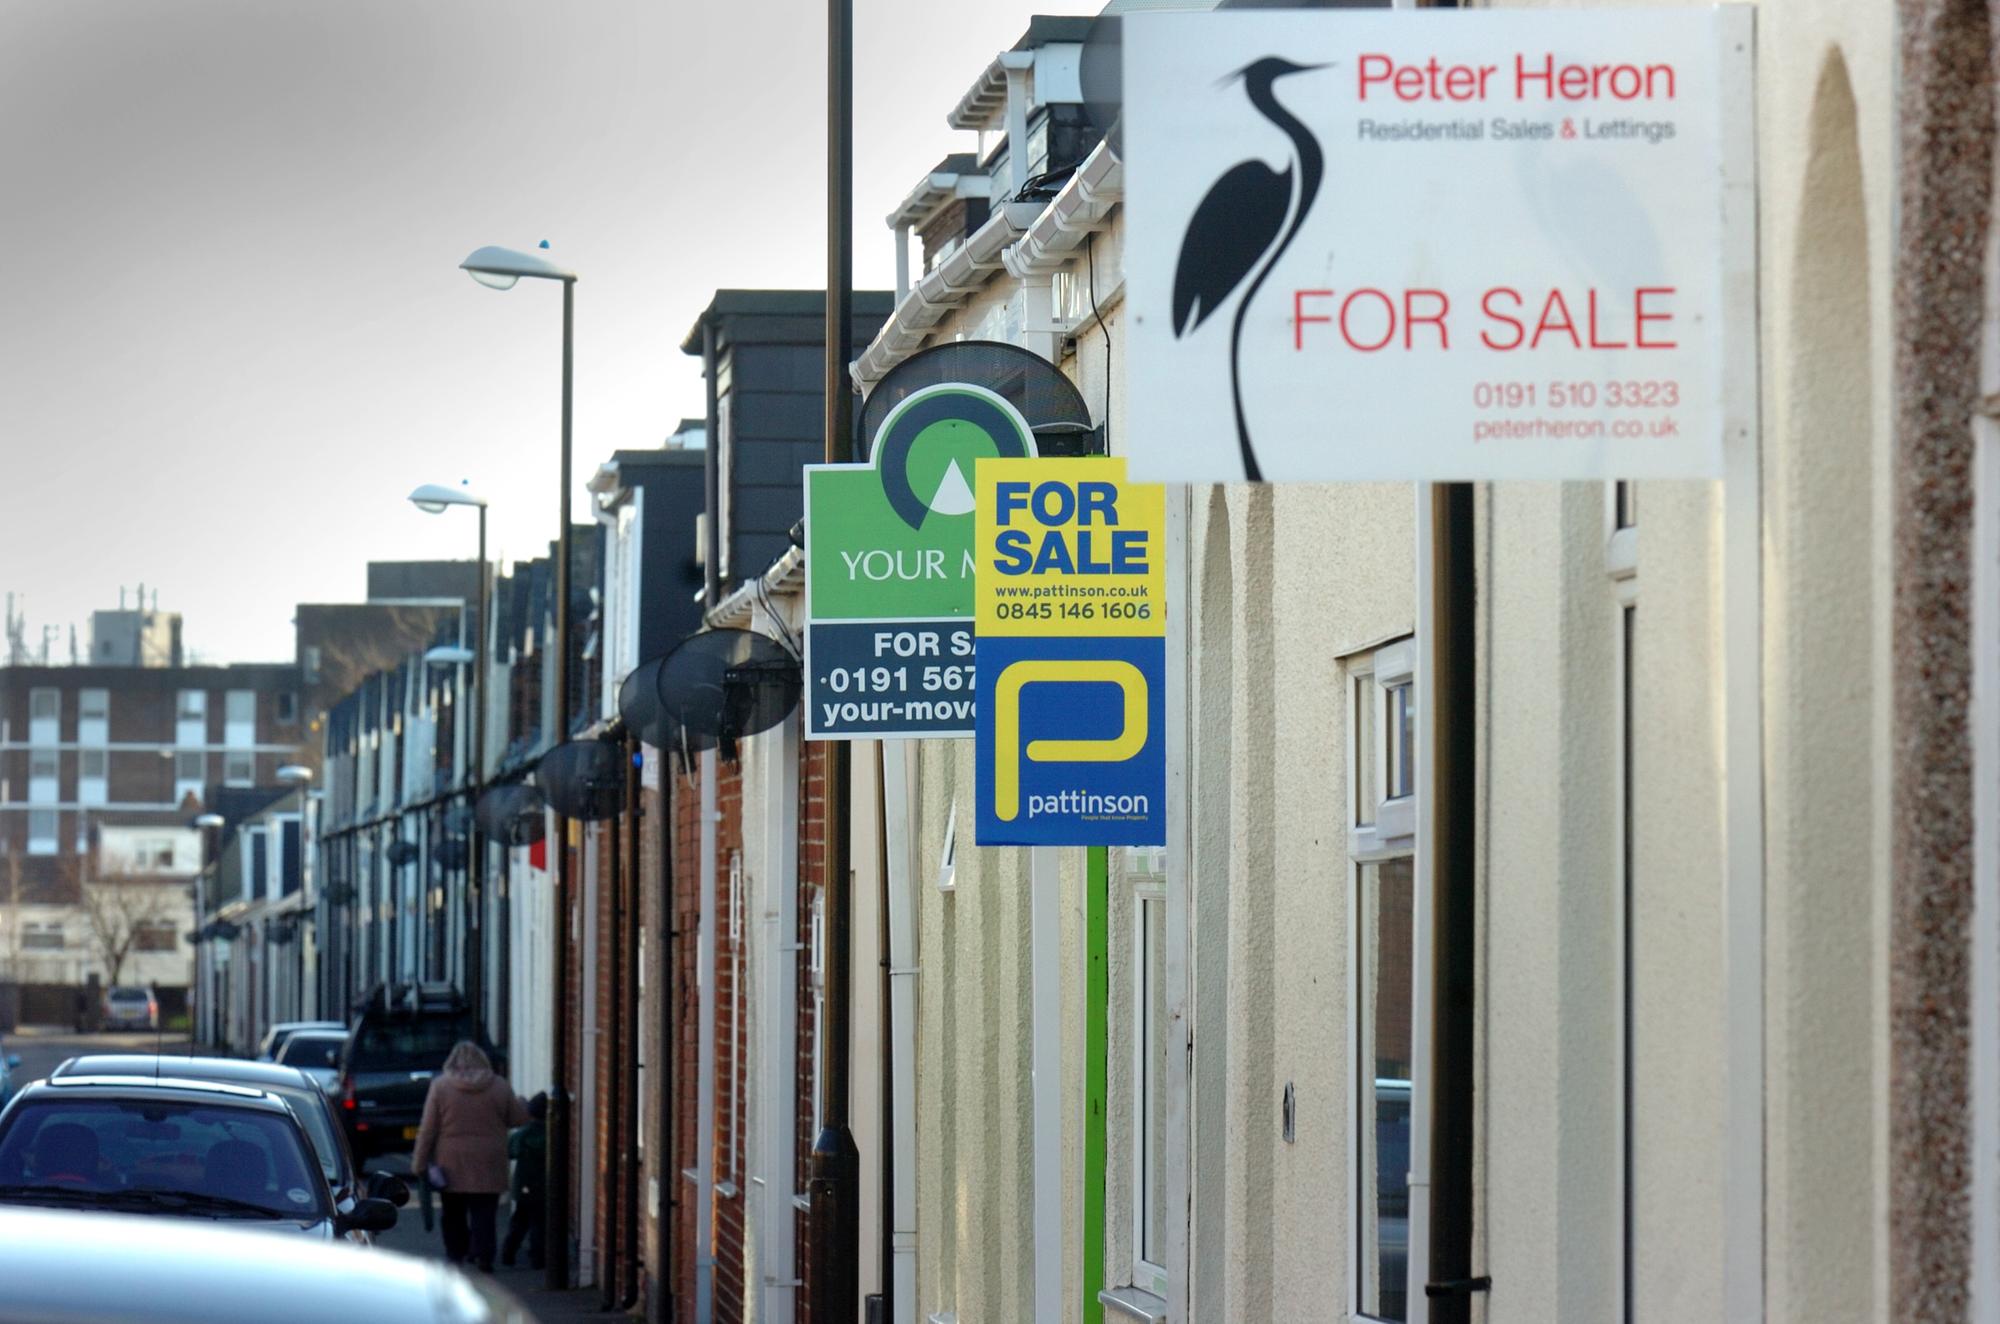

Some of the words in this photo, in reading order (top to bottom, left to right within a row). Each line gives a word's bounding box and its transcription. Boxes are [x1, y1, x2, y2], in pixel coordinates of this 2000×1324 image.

[1357, 52, 1496, 101] Peter
[1514, 52, 1676, 101] Heron
[1357, 118, 1485, 140] Residential
[1490, 118, 1554, 140] Sales
[1561, 117, 1576, 139] &
[1583, 118, 1676, 143] Lettings
[1294, 288, 1450, 352] FOR
[1480, 287, 1678, 351] SALE
[1474, 381, 1536, 409] 0191
[1548, 381, 1597, 408] 510
[1604, 381, 1680, 408] 3323
[1474, 417, 1679, 441] peterheron.co.uk
[996, 481, 1119, 526] FOR
[841, 550, 947, 580] YOUR
[993, 530, 1149, 575] SALE
[995, 584, 1148, 598] www.pattinson.co.uk
[996, 602, 1052, 619] 0845
[1059, 602, 1094, 619] 146
[1101, 602, 1150, 619] 1606
[874, 632, 940, 657] FOR
[950, 631, 976, 656] S
[829, 667, 907, 693] 0191
[823, 700, 976, 727] your-mov
[1028, 790, 1148, 818] pattinson
